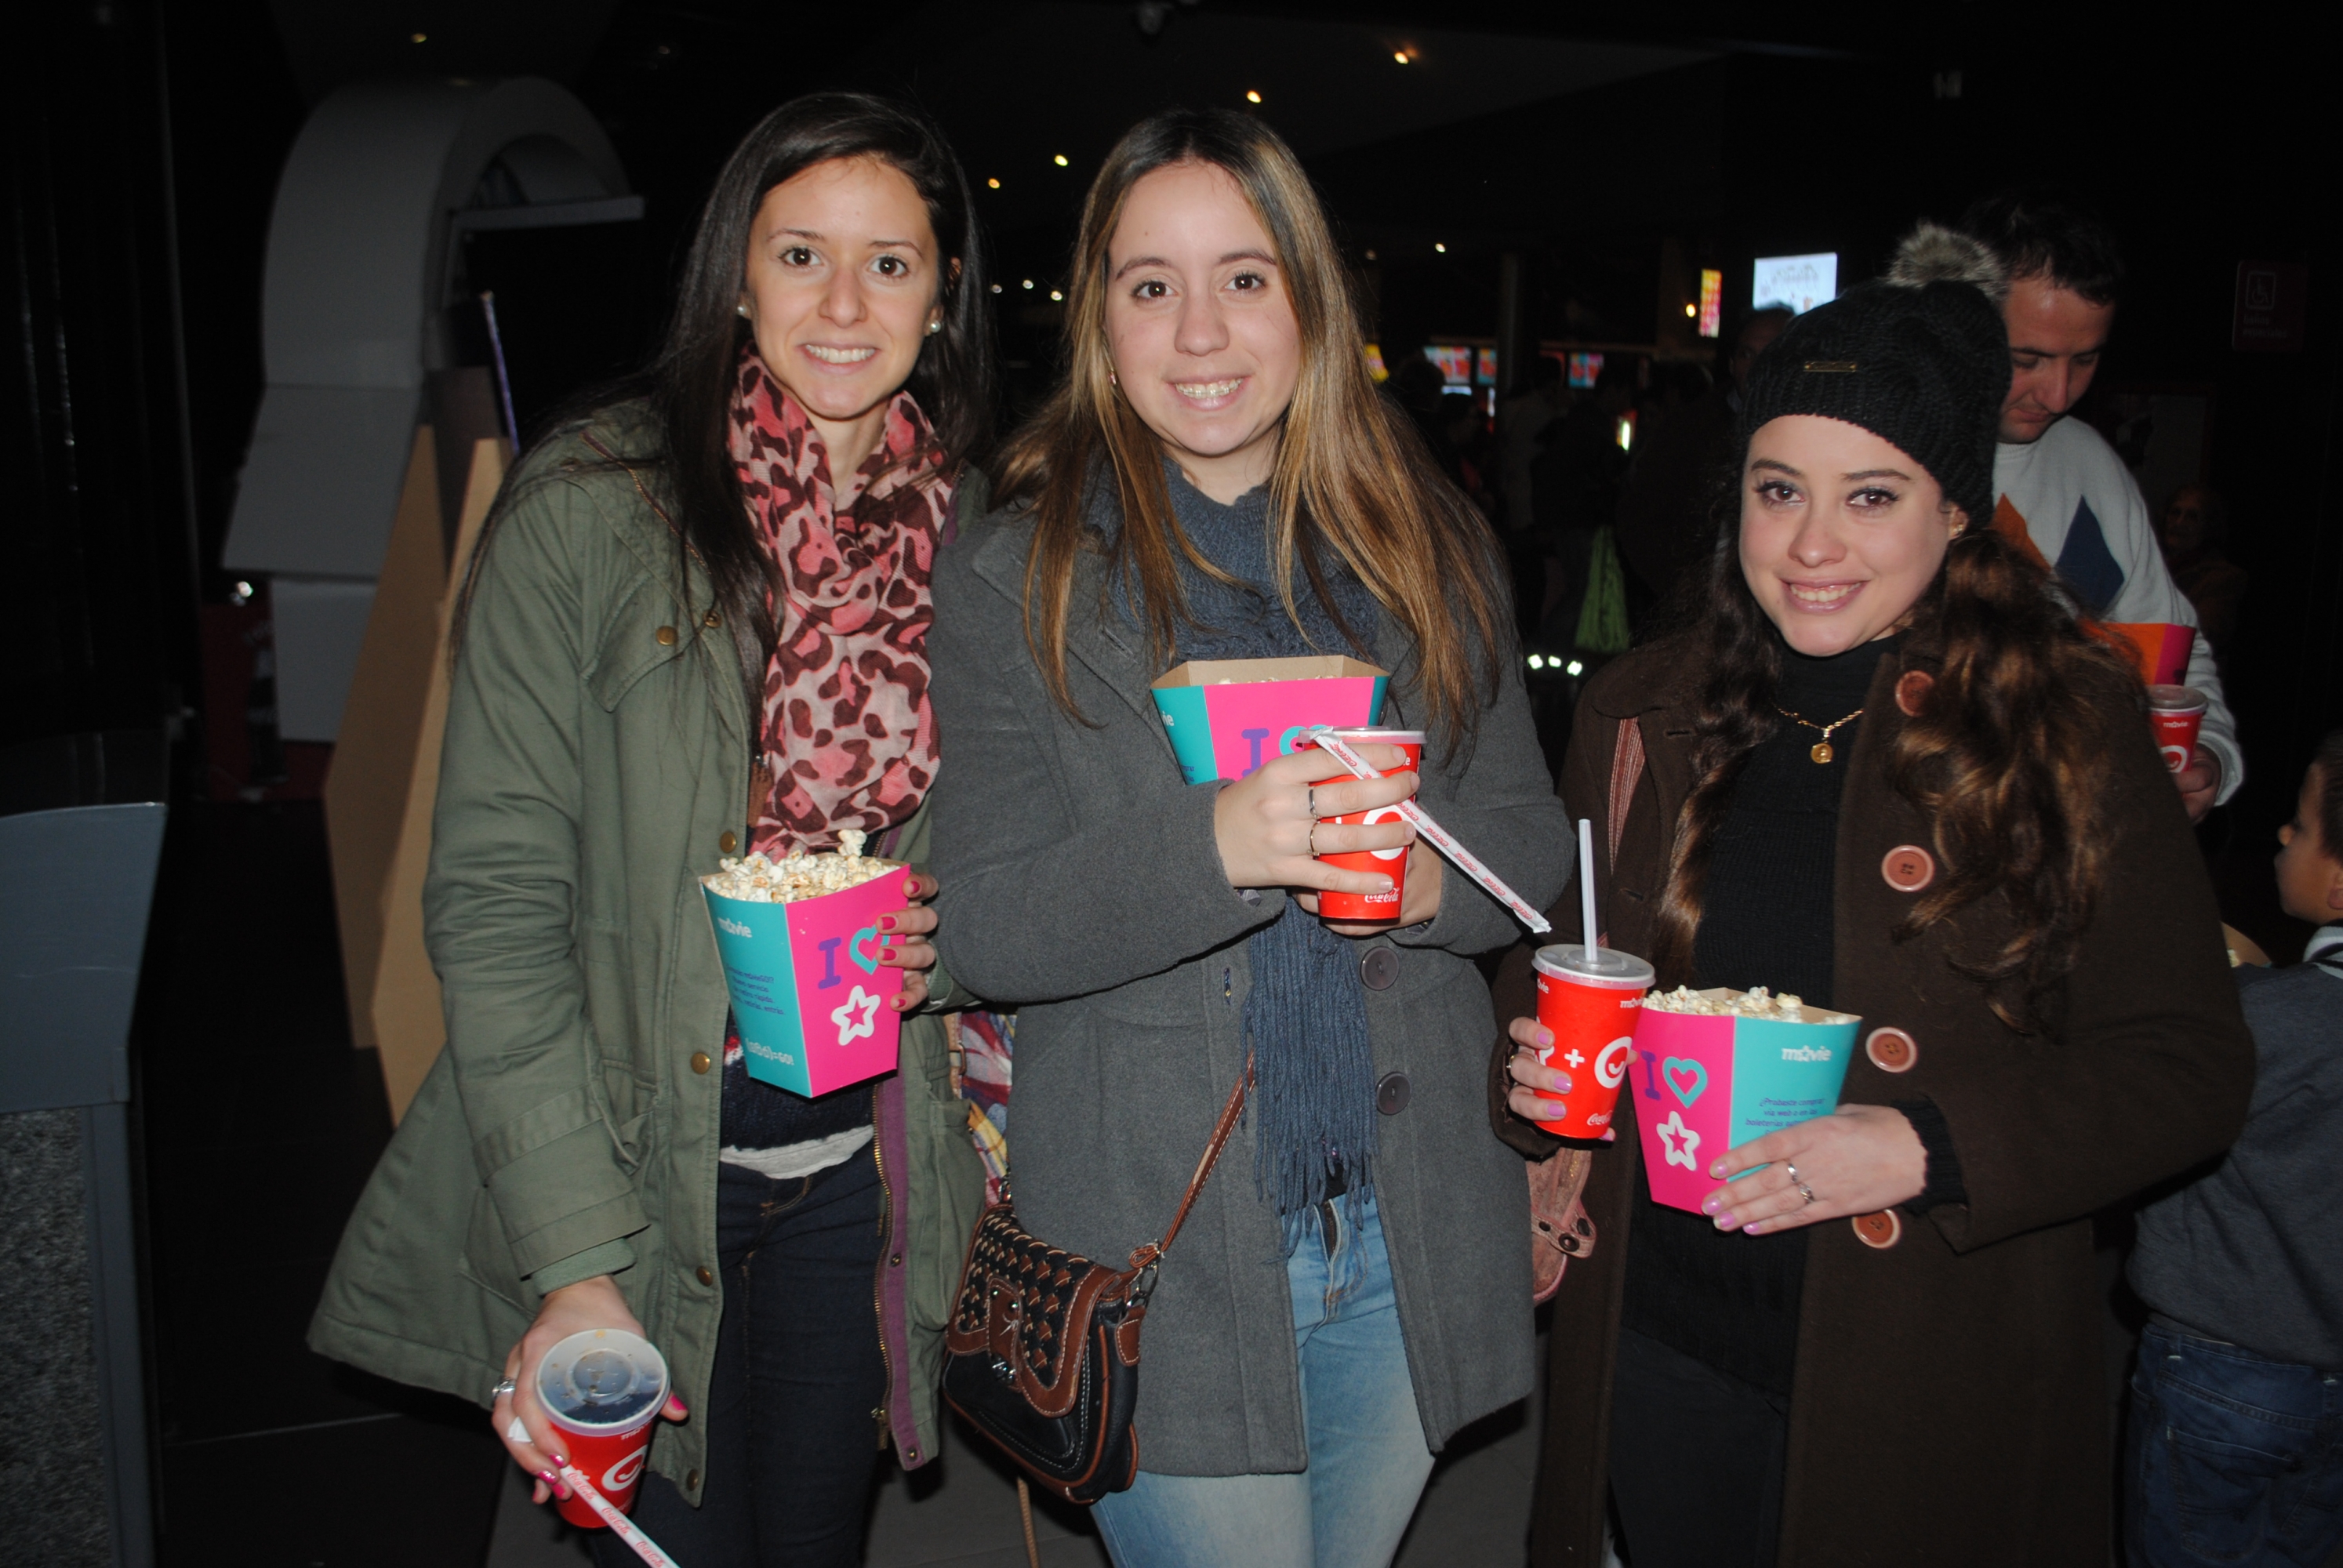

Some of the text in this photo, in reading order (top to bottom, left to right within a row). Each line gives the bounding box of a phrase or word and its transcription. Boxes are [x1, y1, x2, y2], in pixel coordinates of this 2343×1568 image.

[1241, 728, 1270, 777] I
[818, 937, 841, 989] I
[1640, 1050, 1661, 1101] I
